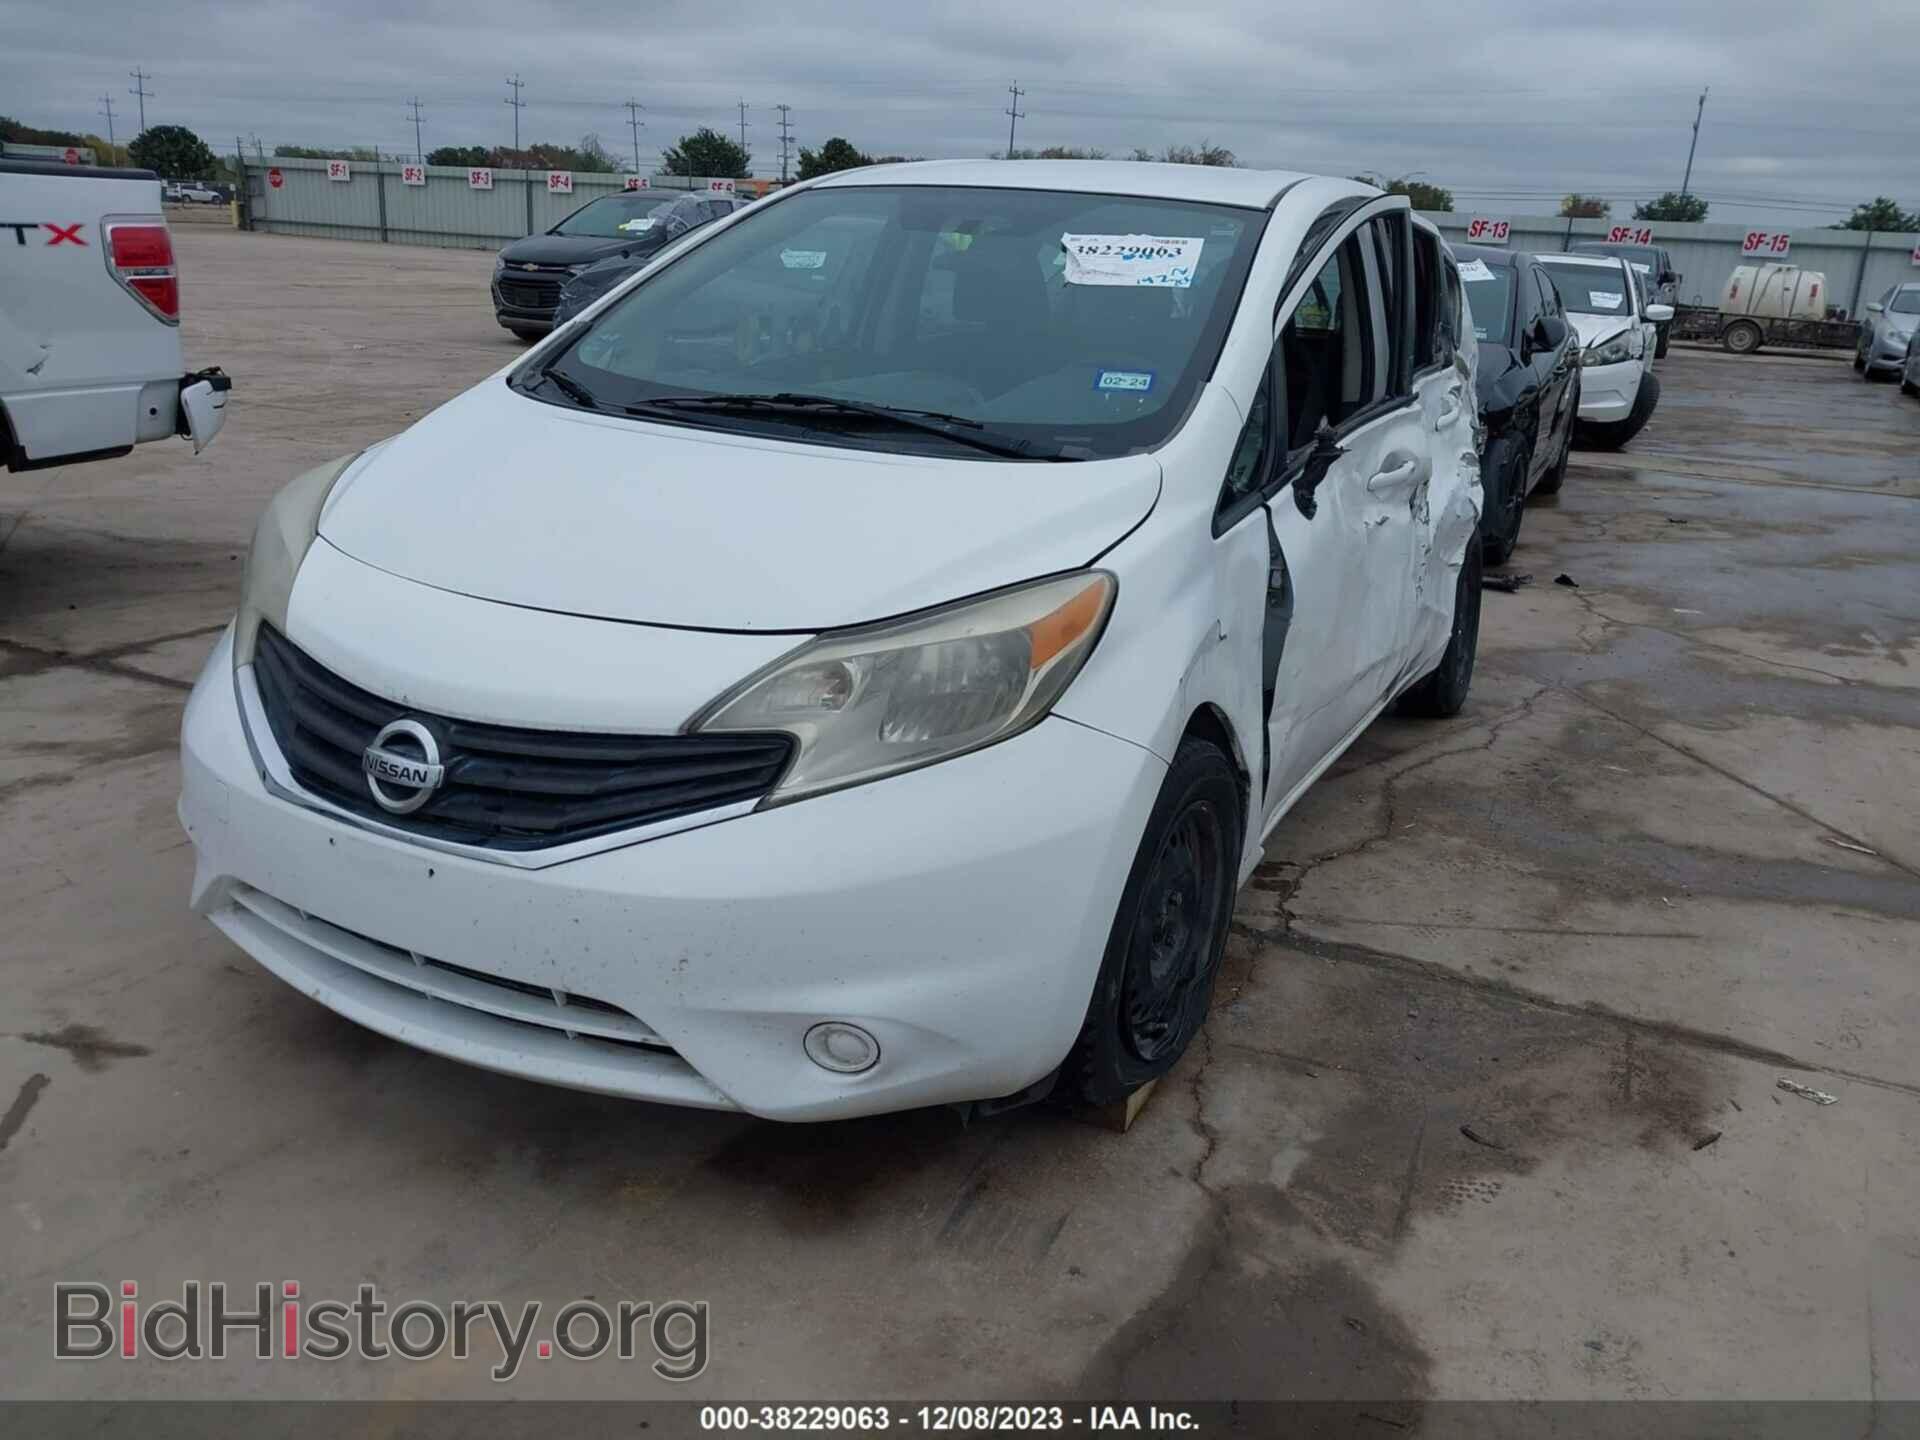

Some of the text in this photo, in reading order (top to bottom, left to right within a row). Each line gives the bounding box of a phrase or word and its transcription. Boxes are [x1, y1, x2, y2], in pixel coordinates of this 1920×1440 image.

[330, 163, 346, 176] SF-1
[404, 167, 423, 181] SF-2
[471, 171, 489, 184] SF-3
[550, 175, 569, 189] SF-4
[1469, 220, 1509, 238] SF-13
[1609, 226, 1651, 244] SF-14
[1744, 233, 1789, 251] SF-15
[1103, 376, 1147, 386] 02-24
[366, 754, 428, 783] NISSAN
